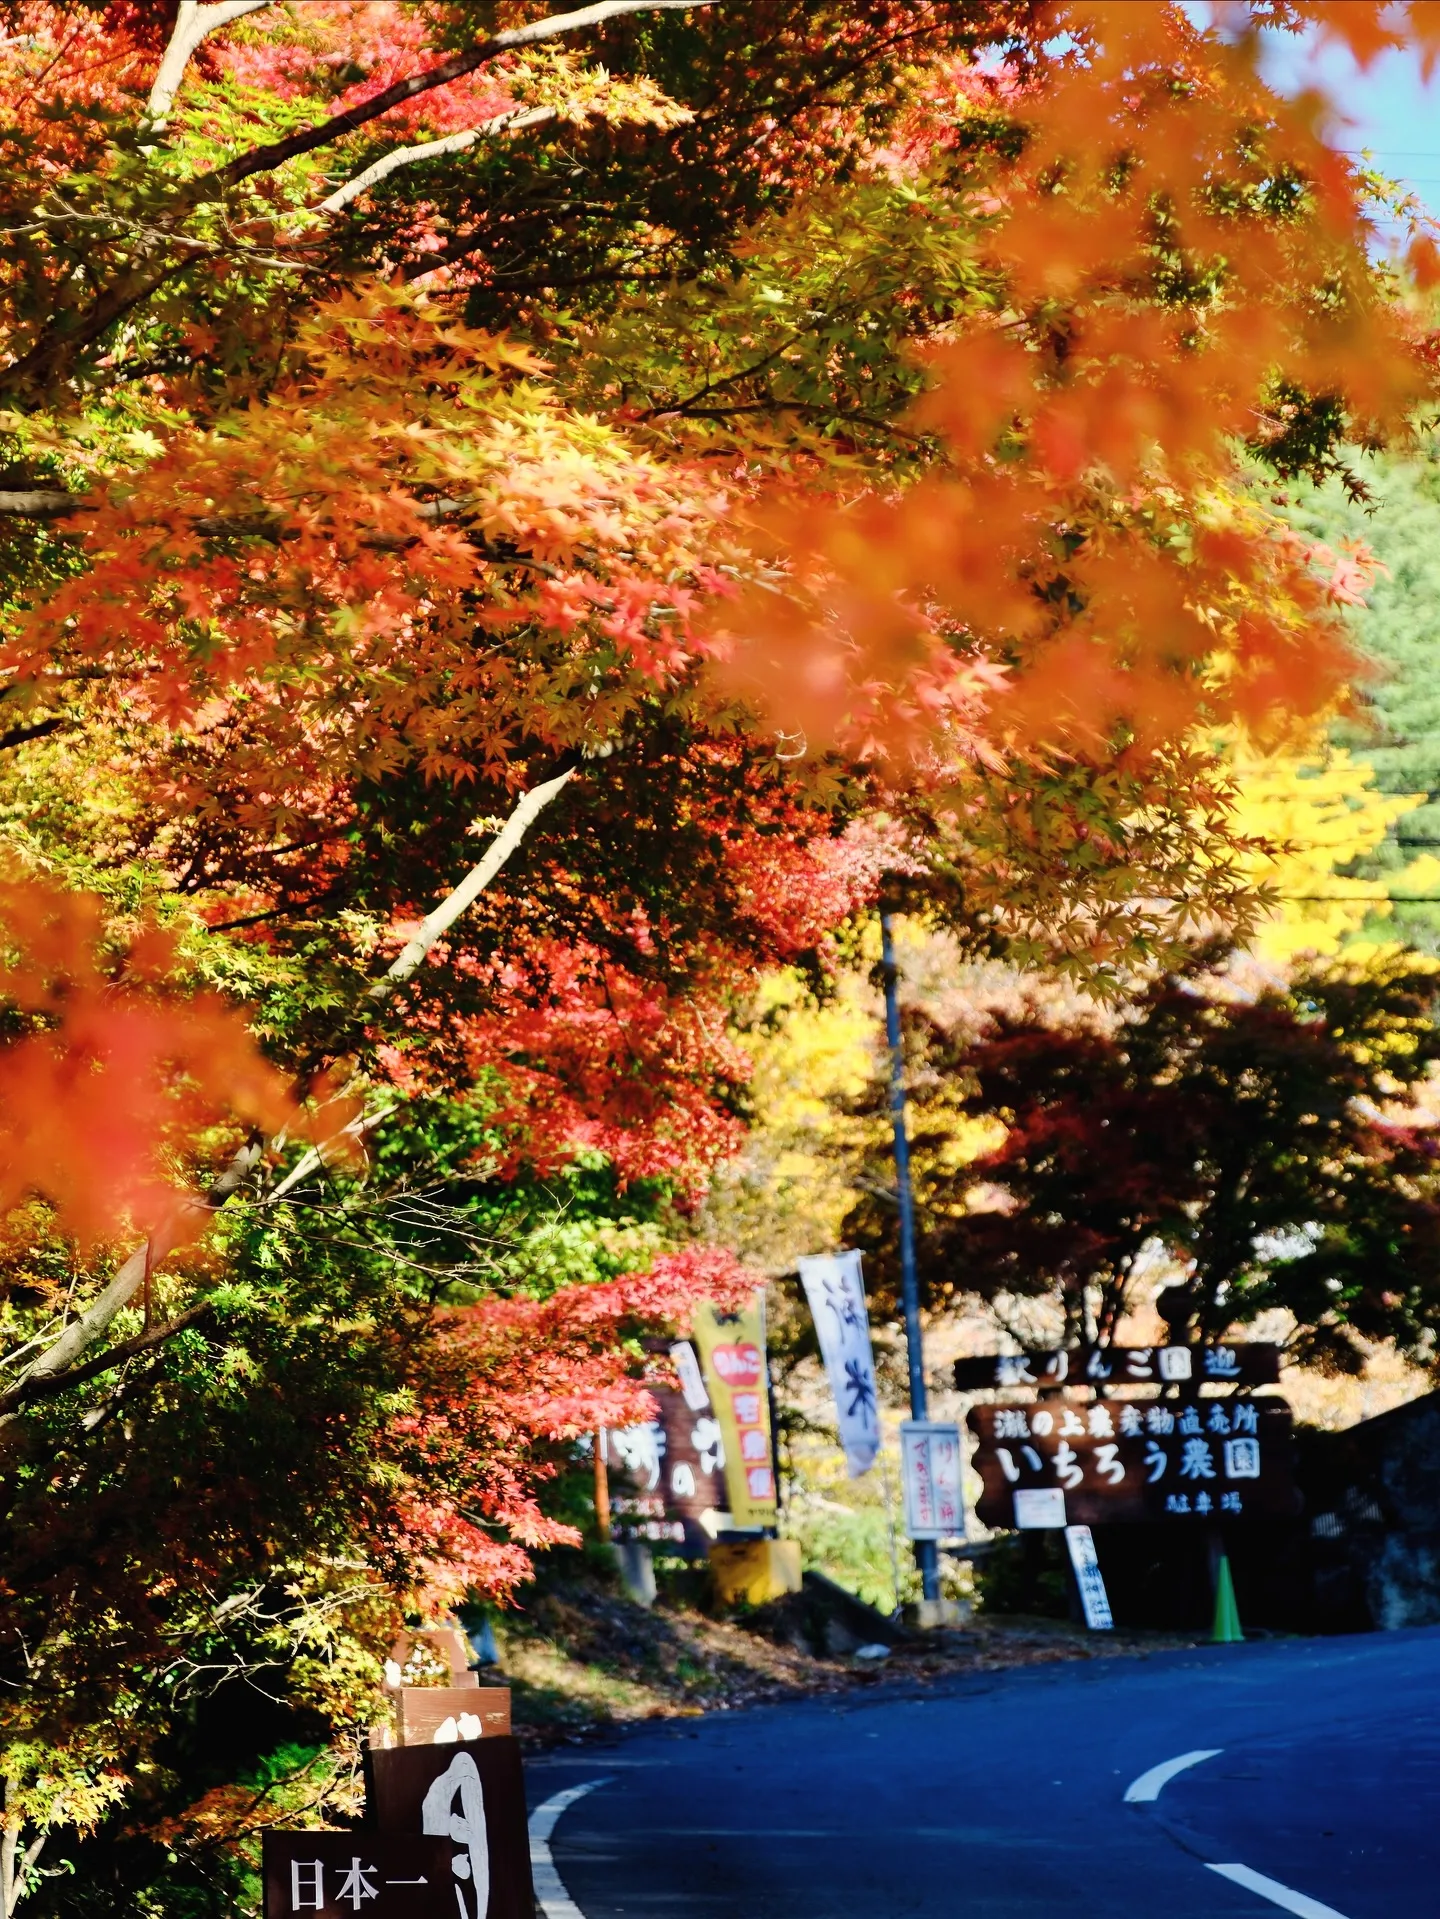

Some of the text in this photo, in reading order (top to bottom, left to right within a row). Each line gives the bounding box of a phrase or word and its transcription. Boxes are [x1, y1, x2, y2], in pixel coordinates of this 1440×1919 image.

[996, 1437, 1260, 1489] いちろう農園
[1165, 1491, 1243, 1516] 駐車場
[290, 1856, 429, 1911] 日本一
